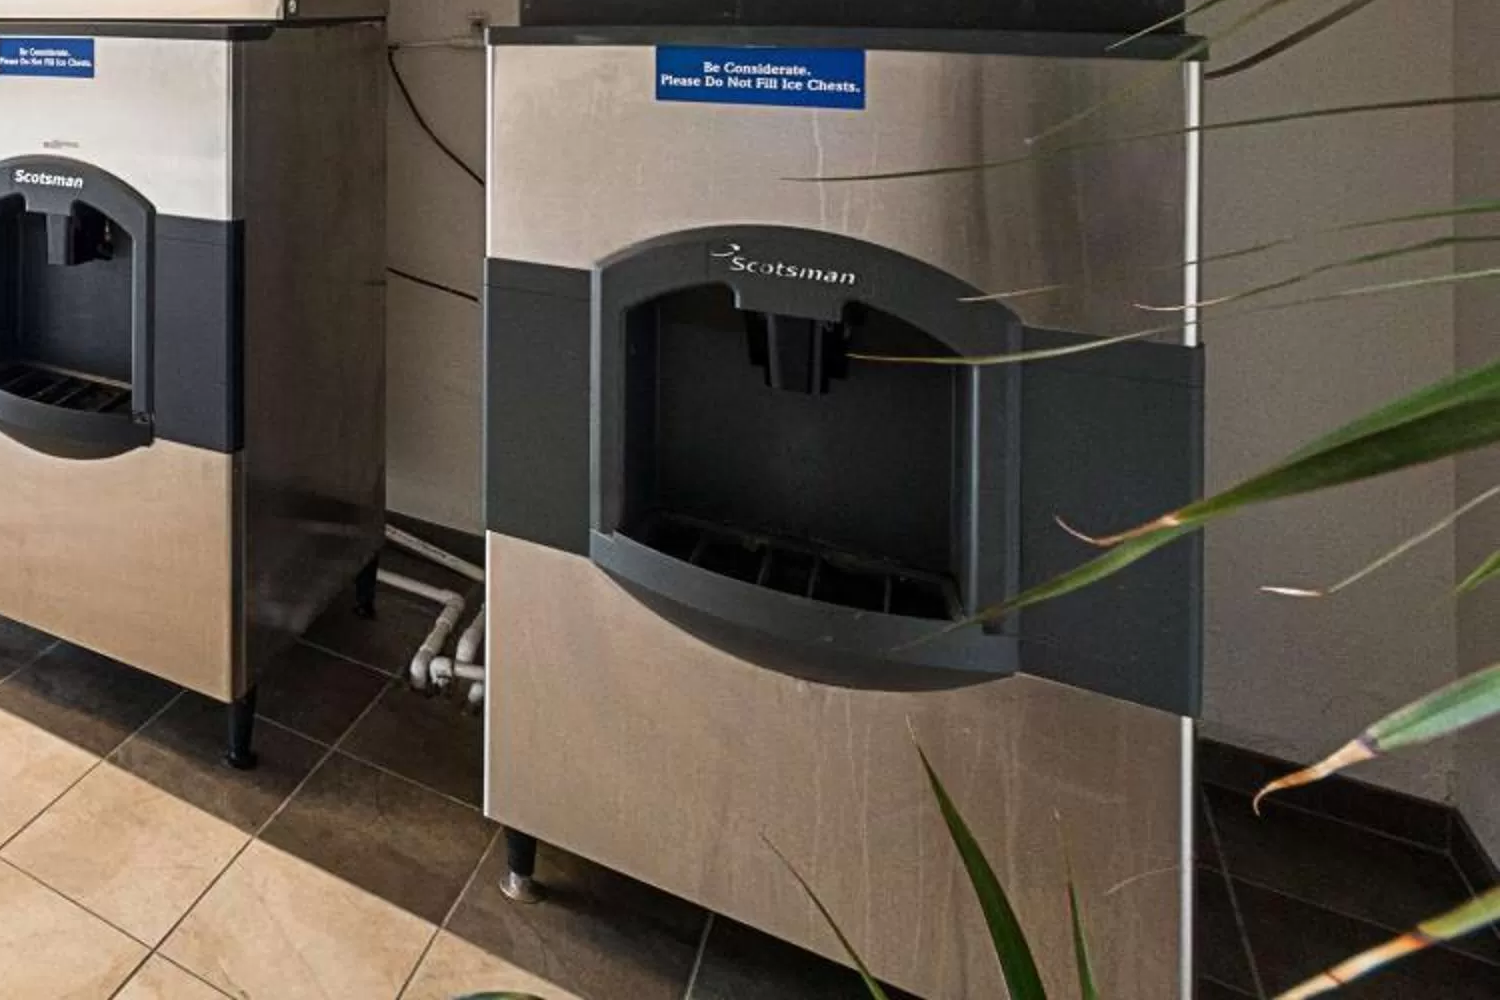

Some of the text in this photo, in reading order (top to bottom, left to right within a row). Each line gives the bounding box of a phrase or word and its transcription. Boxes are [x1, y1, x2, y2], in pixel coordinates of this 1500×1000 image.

[703, 61, 812, 77] Be Considerate.
[660, 73, 861, 93] Please Do Not Fill Ice Chests.
[14, 169, 84, 189] Scotsman
[729, 255, 857, 285] Scotsman
